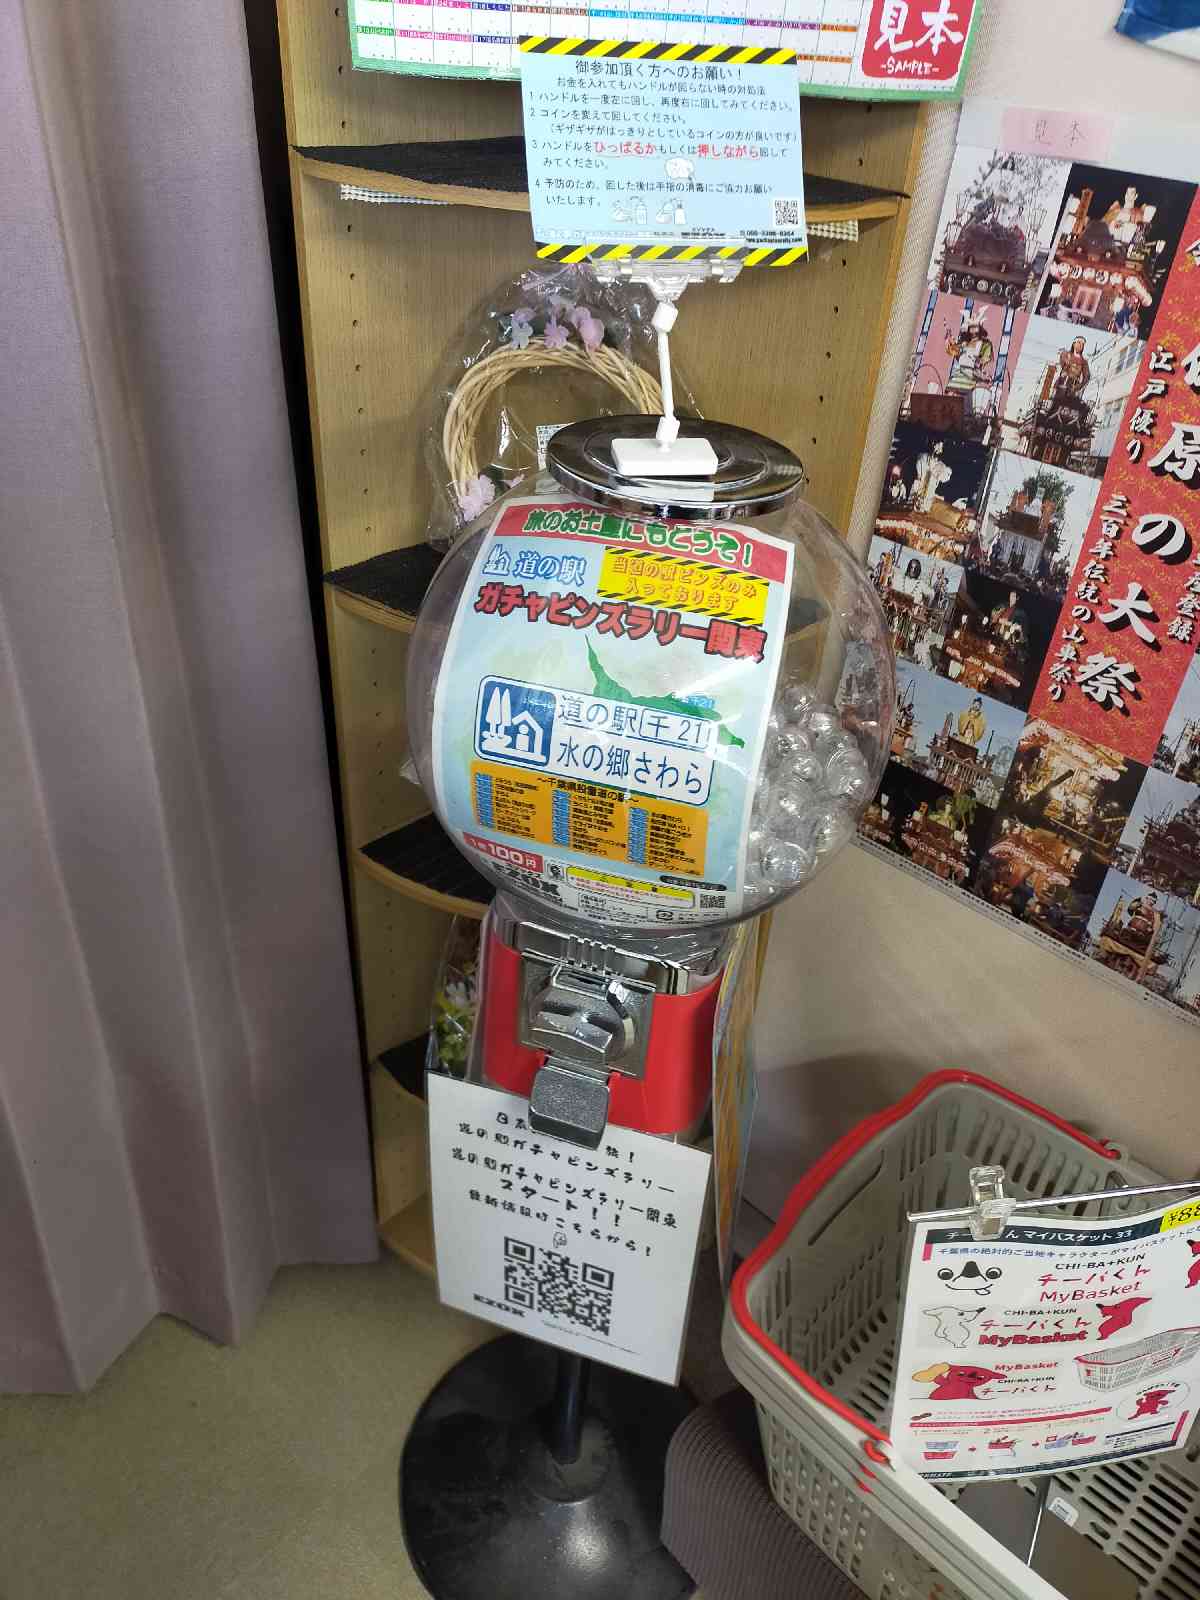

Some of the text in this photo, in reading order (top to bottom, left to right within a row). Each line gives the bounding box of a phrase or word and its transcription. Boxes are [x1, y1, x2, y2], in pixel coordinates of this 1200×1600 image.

[873, 0, 965, 56] 見本
[575, 59, 741, 80] 御参加頂く方へのお願い！
[512, 550, 587, 587] 道の駅
[473, 581, 768, 664] ガチャピンズラリー関東
[558, 694, 640, 737] 道の駅
[556, 735, 703, 795] 水の郷さわら
[1040, 1281, 1143, 1304] MyBasket
[978, 1329, 1089, 1348] MyBasket
[994, 1361, 1059, 1372] MyBasket
